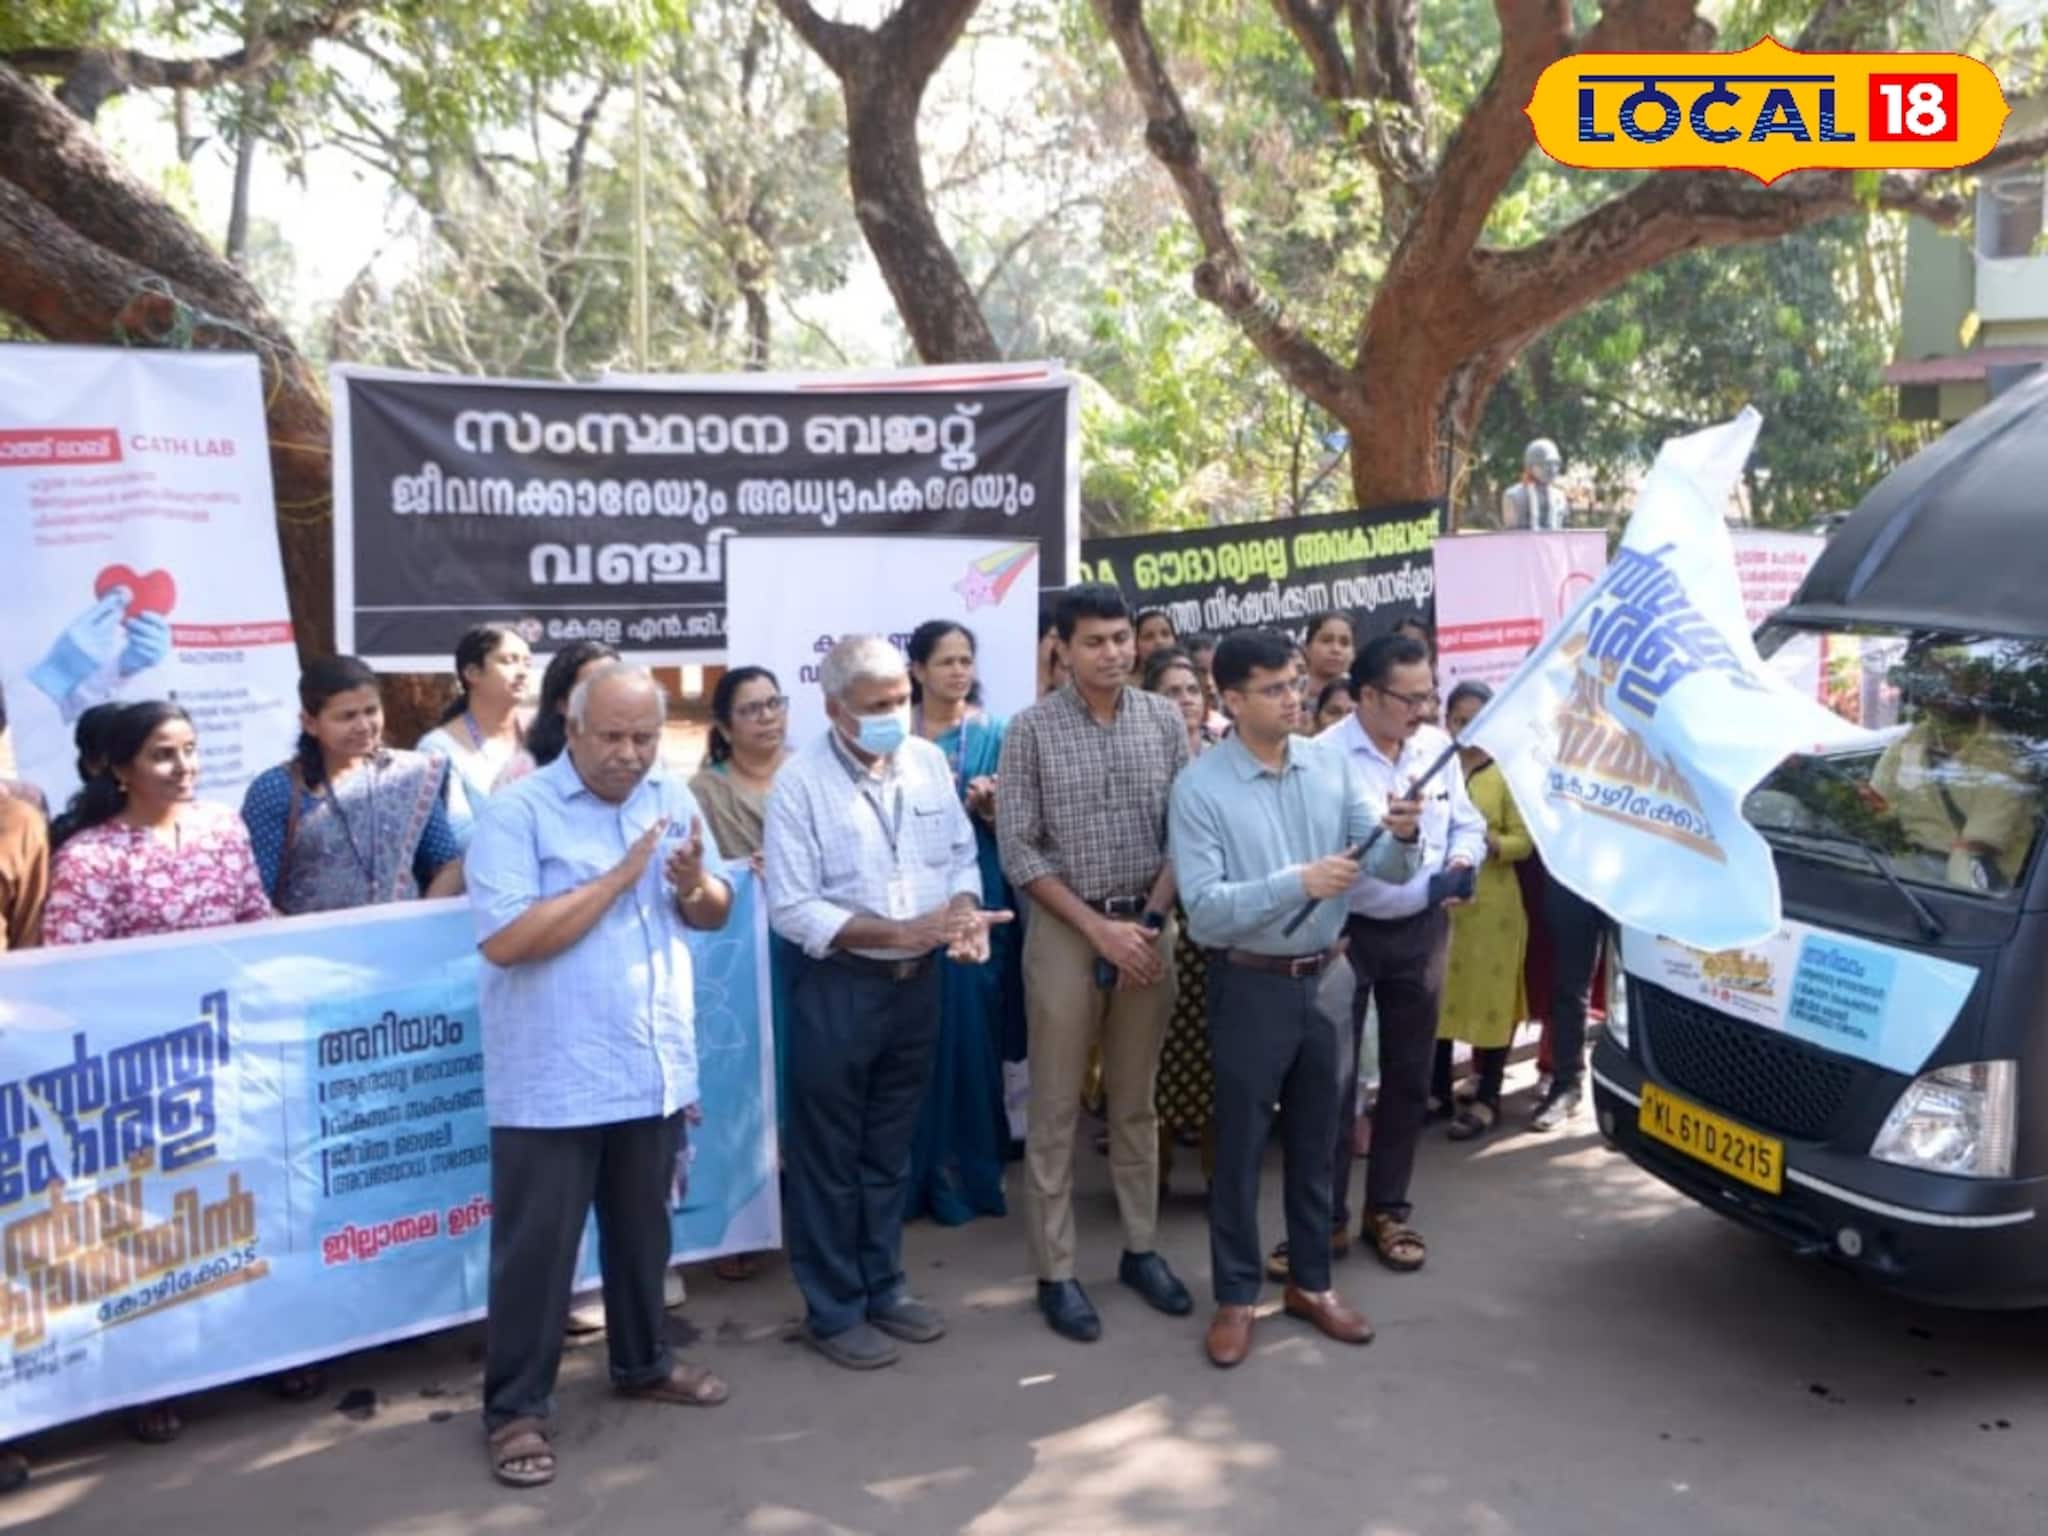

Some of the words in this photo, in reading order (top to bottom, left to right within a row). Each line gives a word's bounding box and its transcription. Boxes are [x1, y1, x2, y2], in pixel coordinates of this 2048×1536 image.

[130, 435, 188, 455] CATH
[194, 438, 236, 457] LAB
[454, 409, 790, 454] സംസ്ഥാന
[804, 402, 983, 471] ബജറ്റ്
[392, 464, 727, 525] ജീവനക്കാരേയും
[737, 472, 1035, 527] അധ്യാപകരേയും
[529, 527, 738, 585] വഞ്ചി
[547, 618, 624, 643] കേരള
[627, 611, 727, 642] എൻ.ജി.
[318, 1010, 464, 1068] അറിയാം
[1721, 1131, 1772, 1178] 2215
[323, 1210, 439, 1265] ജില്ലാതല
[97, 1236, 262, 1326] കോഴിക്കോട്
